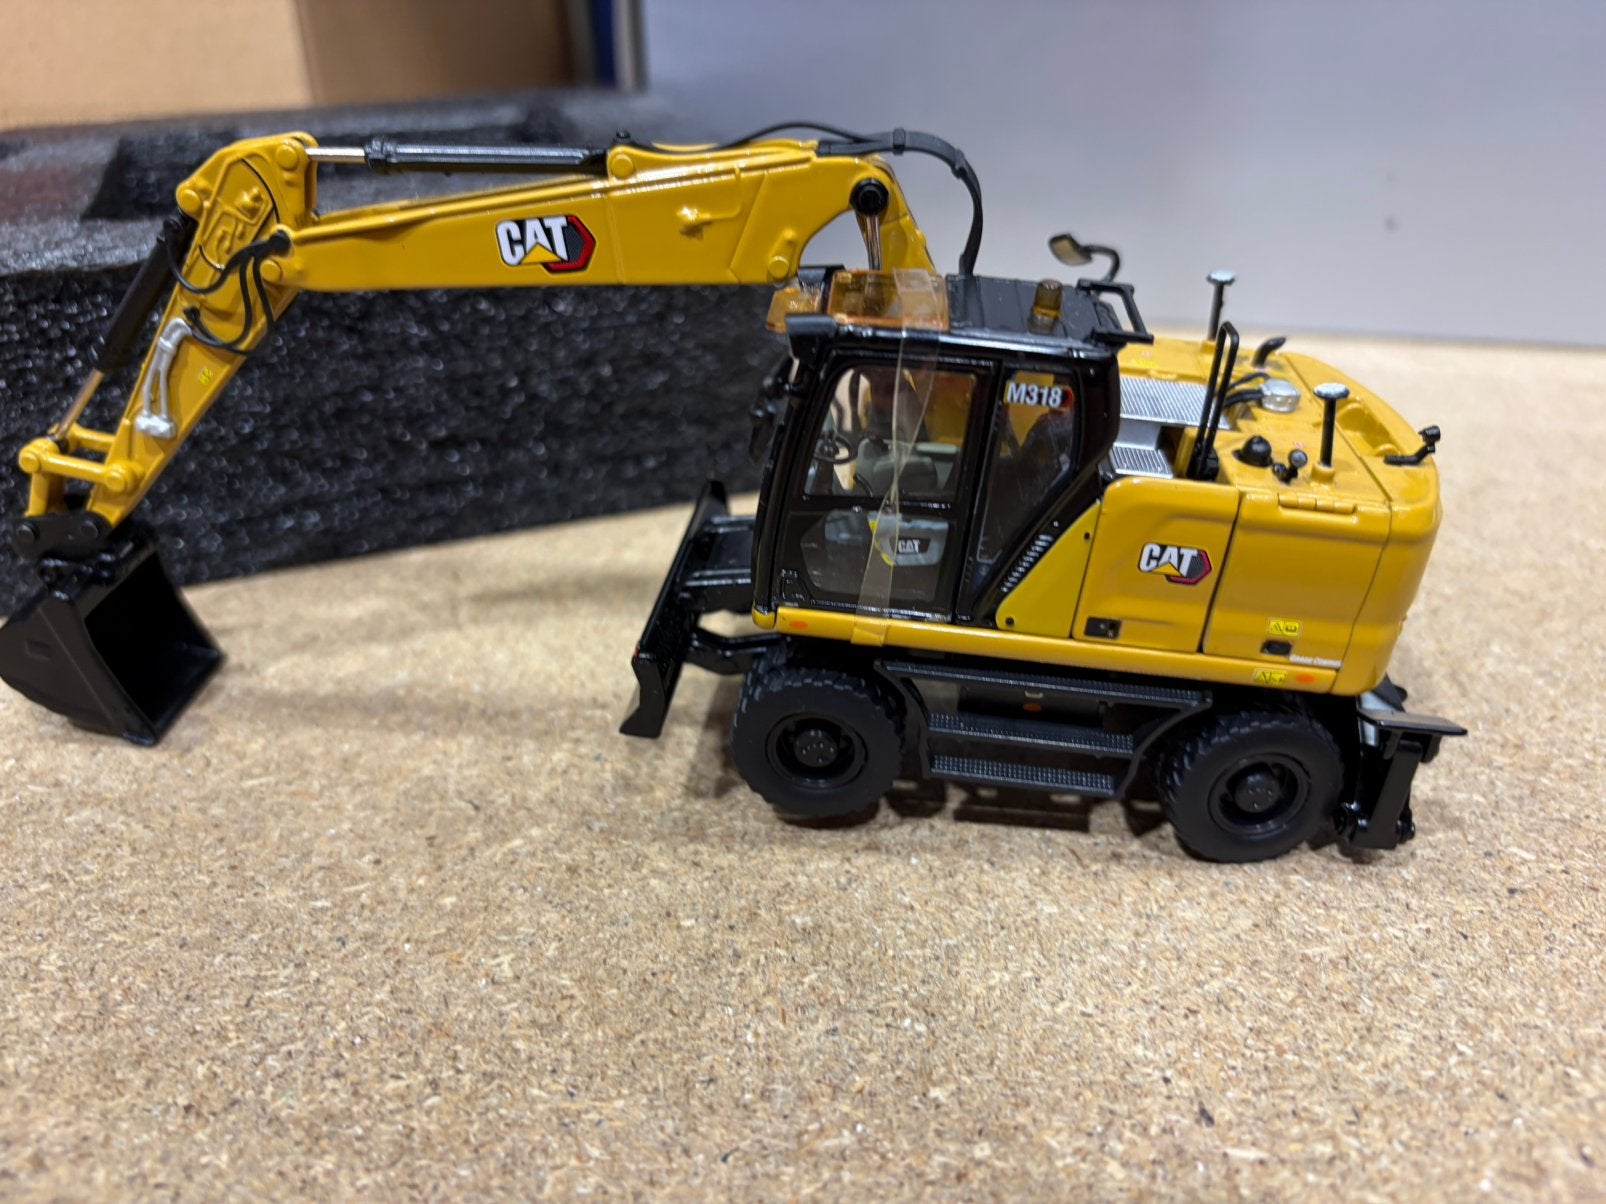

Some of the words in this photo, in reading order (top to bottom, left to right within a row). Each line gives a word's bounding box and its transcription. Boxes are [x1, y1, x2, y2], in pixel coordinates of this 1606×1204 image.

[497, 215, 568, 266] CAT
[1006, 381, 1062, 408] M318
[1139, 542, 1198, 577] CAT
